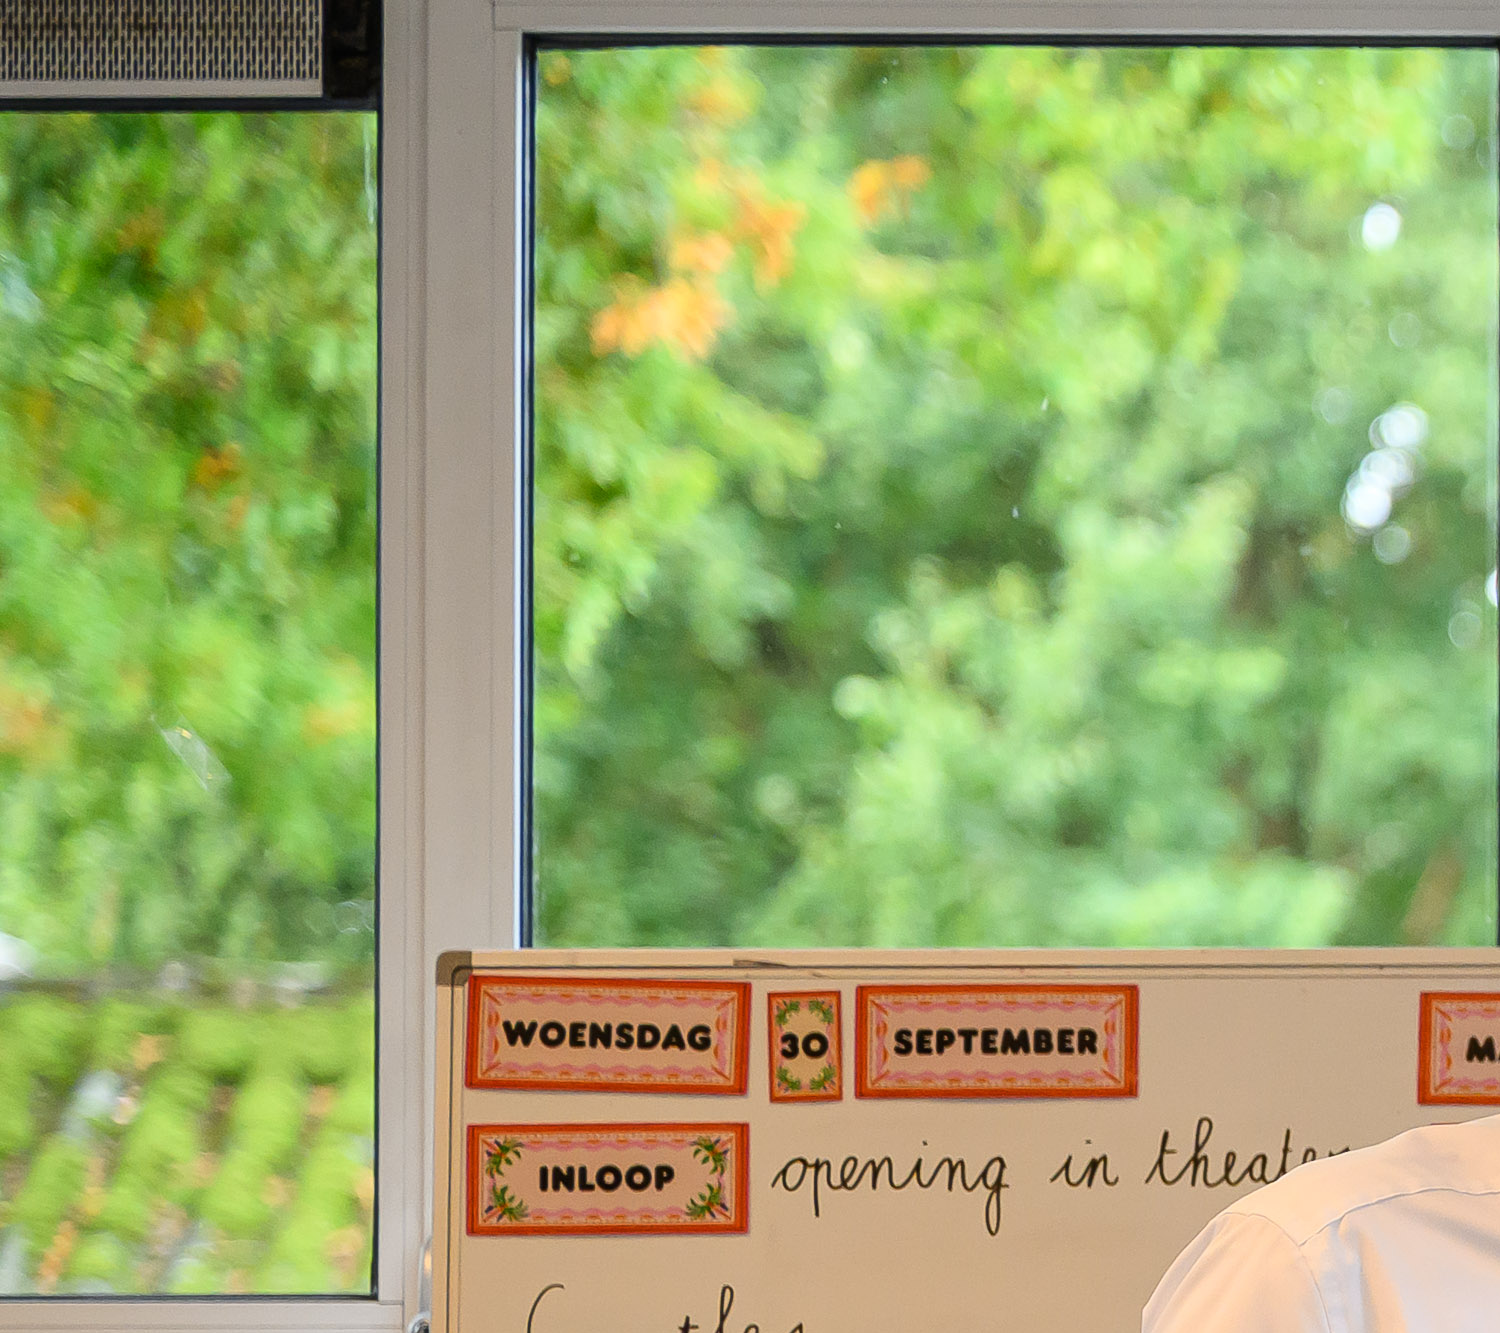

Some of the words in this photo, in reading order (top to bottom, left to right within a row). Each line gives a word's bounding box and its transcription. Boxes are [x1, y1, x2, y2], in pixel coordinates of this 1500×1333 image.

[501, 1019, 713, 1053] WOENSDAG
[780, 1031, 830, 1061] 30
[892, 1027, 1099, 1057] SEPTEMBER
[538, 1163, 676, 1194] INLOOP
[770, 1139, 1009, 1238] opening
[1048, 1138, 1120, 1190] in
